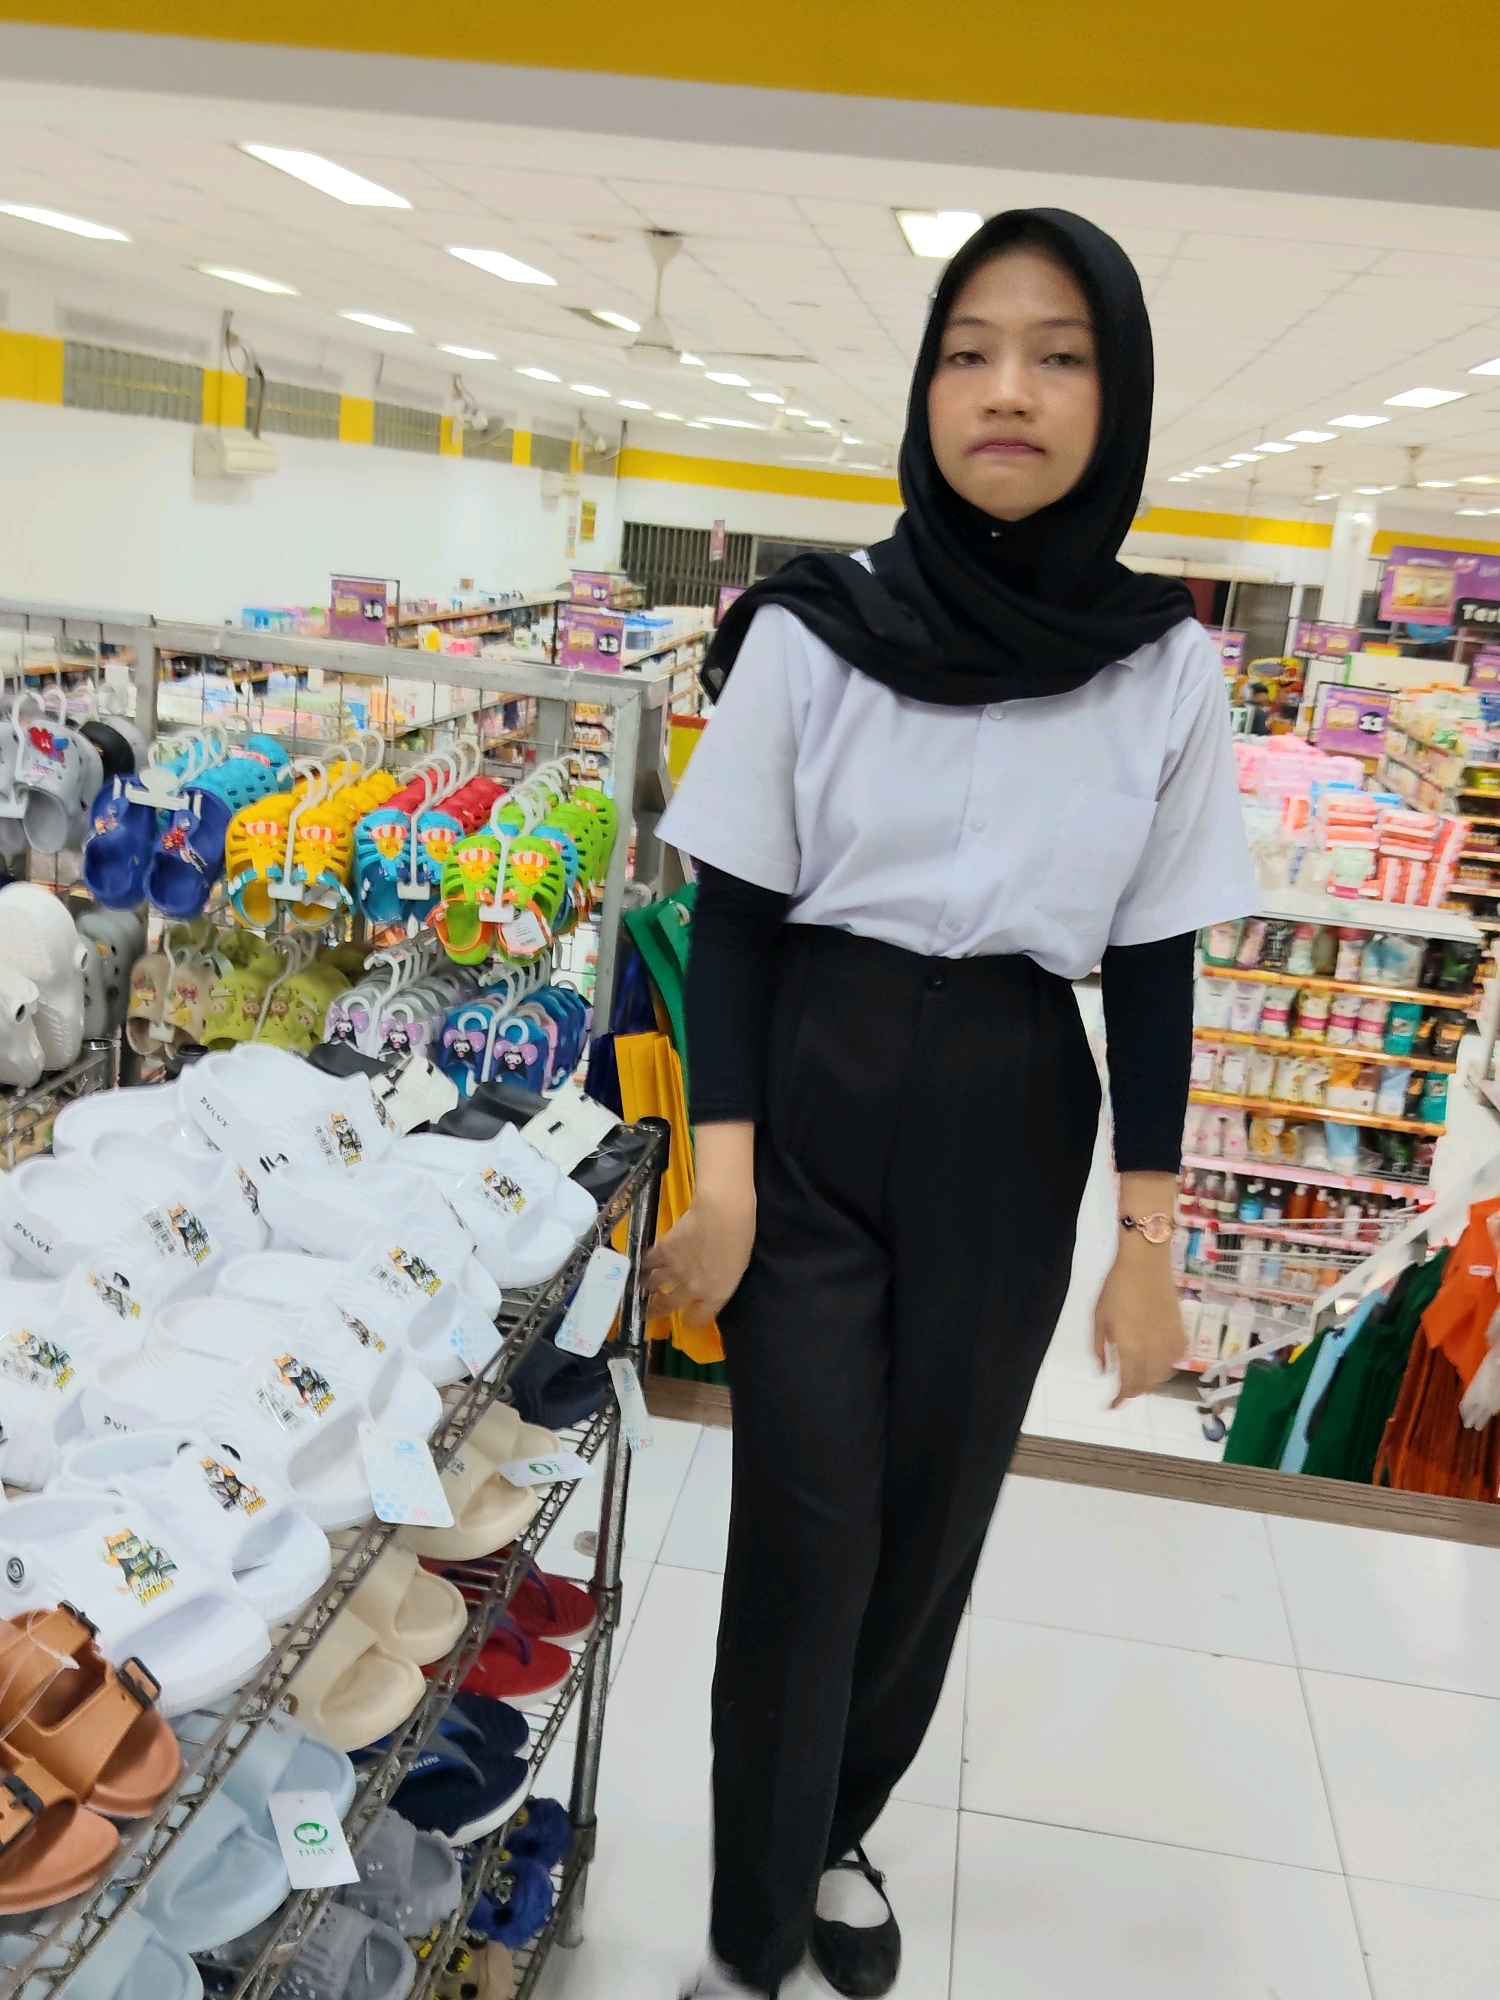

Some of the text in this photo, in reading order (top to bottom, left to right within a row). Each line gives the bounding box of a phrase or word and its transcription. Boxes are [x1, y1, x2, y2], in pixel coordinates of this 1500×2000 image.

[1461, 603, 1500, 624] Ter
[13, 1221, 54, 1256] DULUX
[138, 1576, 175, 1608] MANIA
